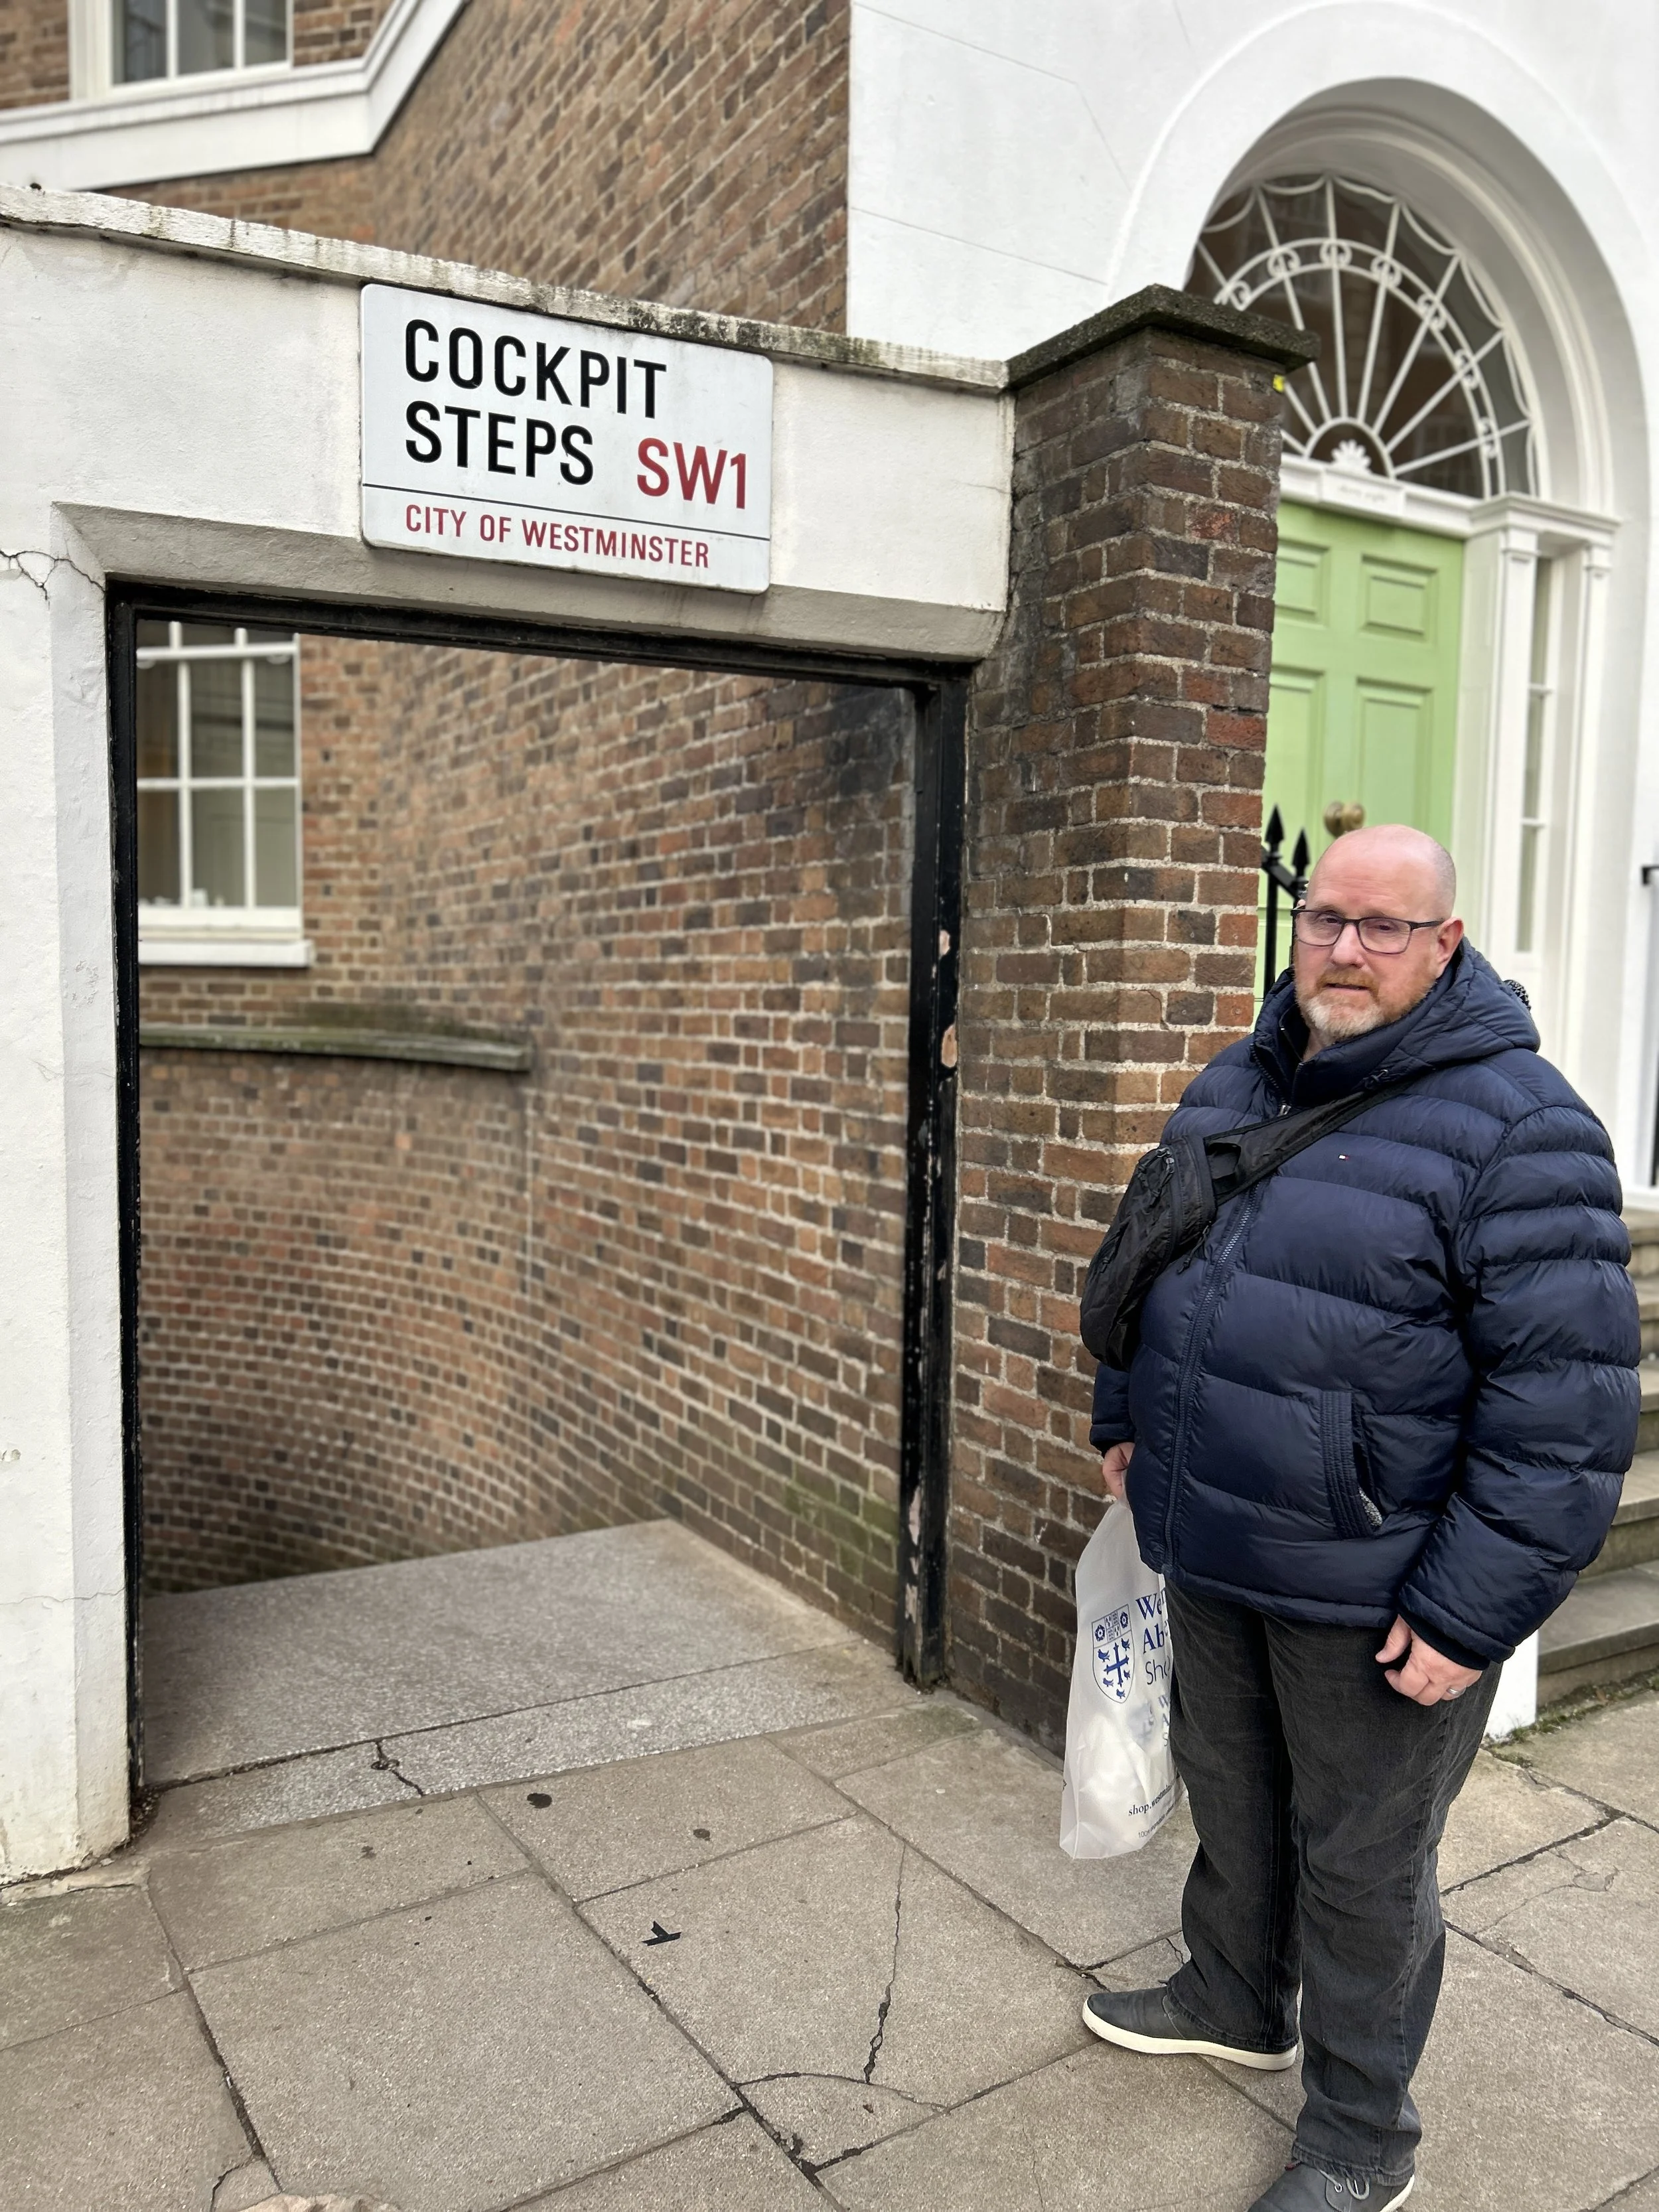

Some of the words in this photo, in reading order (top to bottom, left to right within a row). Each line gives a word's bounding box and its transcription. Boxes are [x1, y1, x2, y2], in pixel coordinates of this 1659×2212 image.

[405, 319, 667, 419] COCKPIT
[405, 400, 594, 486] STEPS
[637, 437, 746, 510] SW1
[405, 504, 467, 537] CITY
[479, 514, 512, 544] OF
[522, 518, 709, 569] WESTMINSTER
